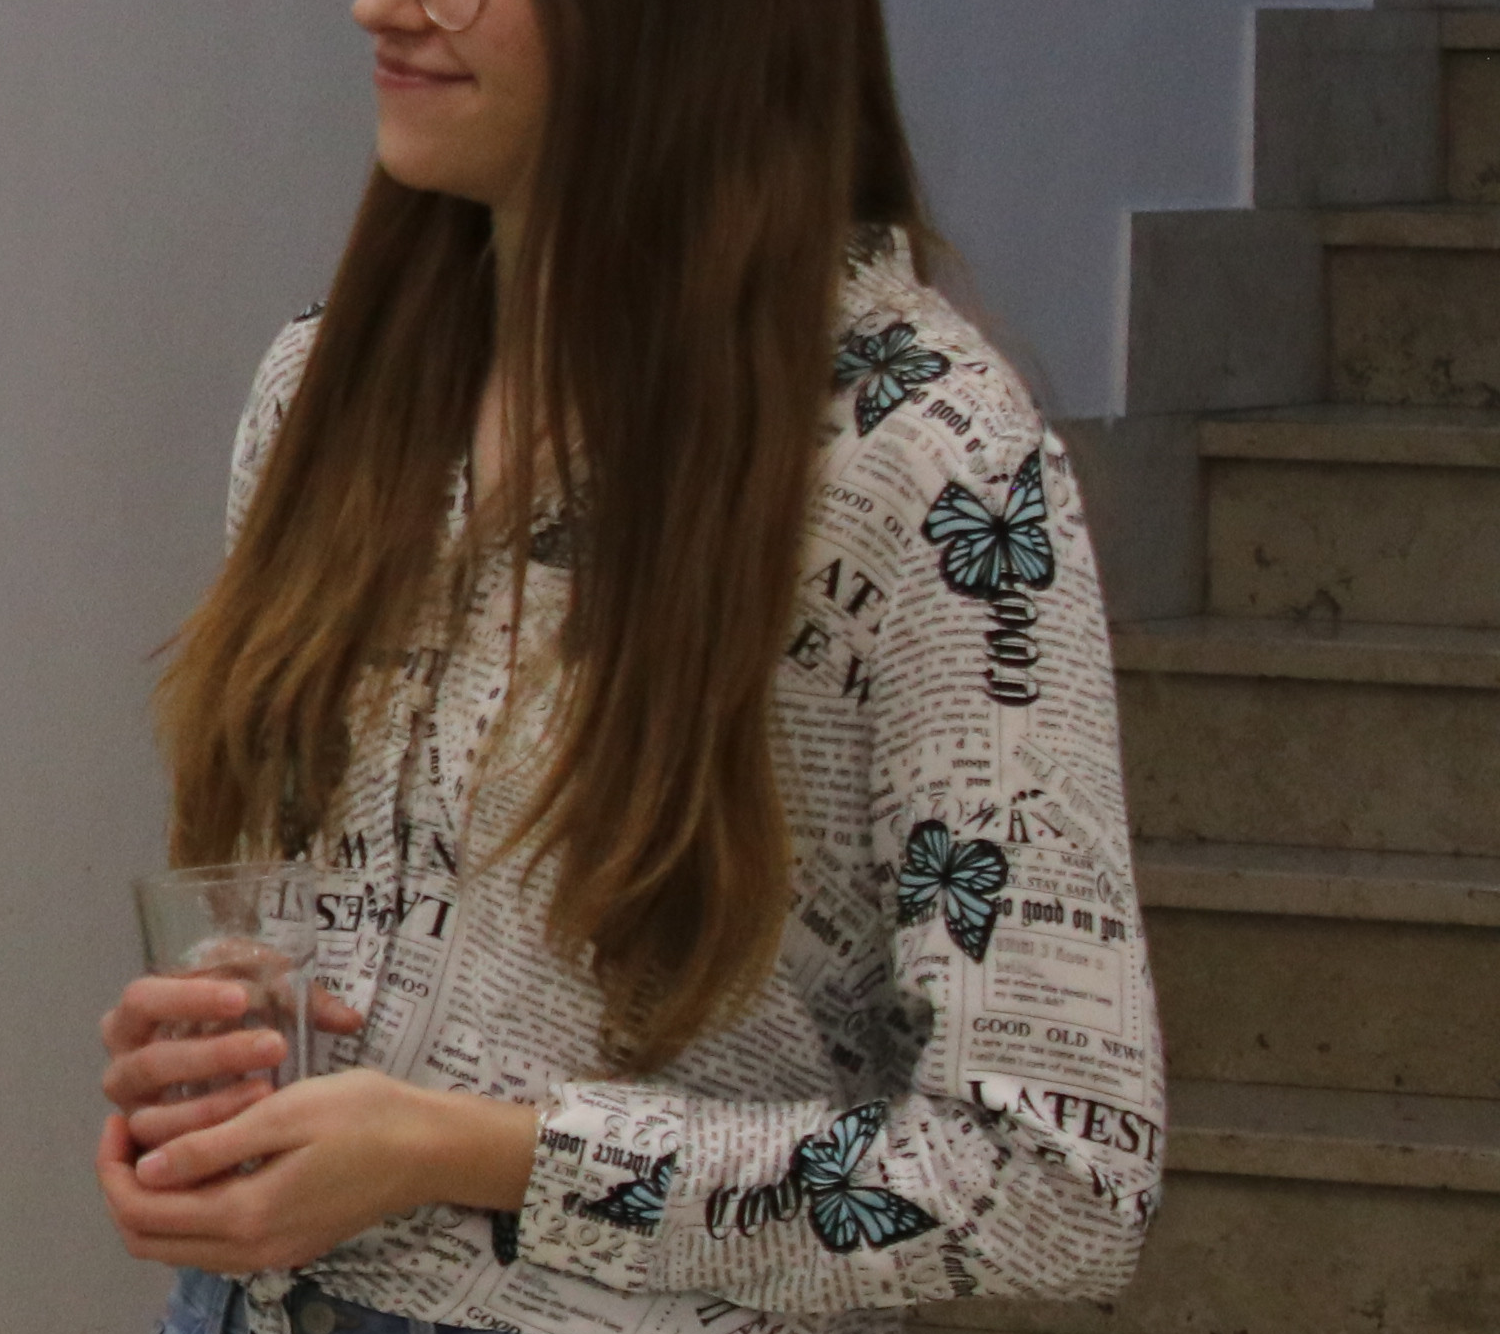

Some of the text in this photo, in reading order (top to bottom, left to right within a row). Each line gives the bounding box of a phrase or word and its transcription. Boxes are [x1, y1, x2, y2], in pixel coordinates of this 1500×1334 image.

[1021, 897, 1064, 927] good
[973, 1017, 1032, 1038] GOOD
[1046, 1027, 1090, 1048] OLD
[967, 1080, 1162, 1163] LATEST
